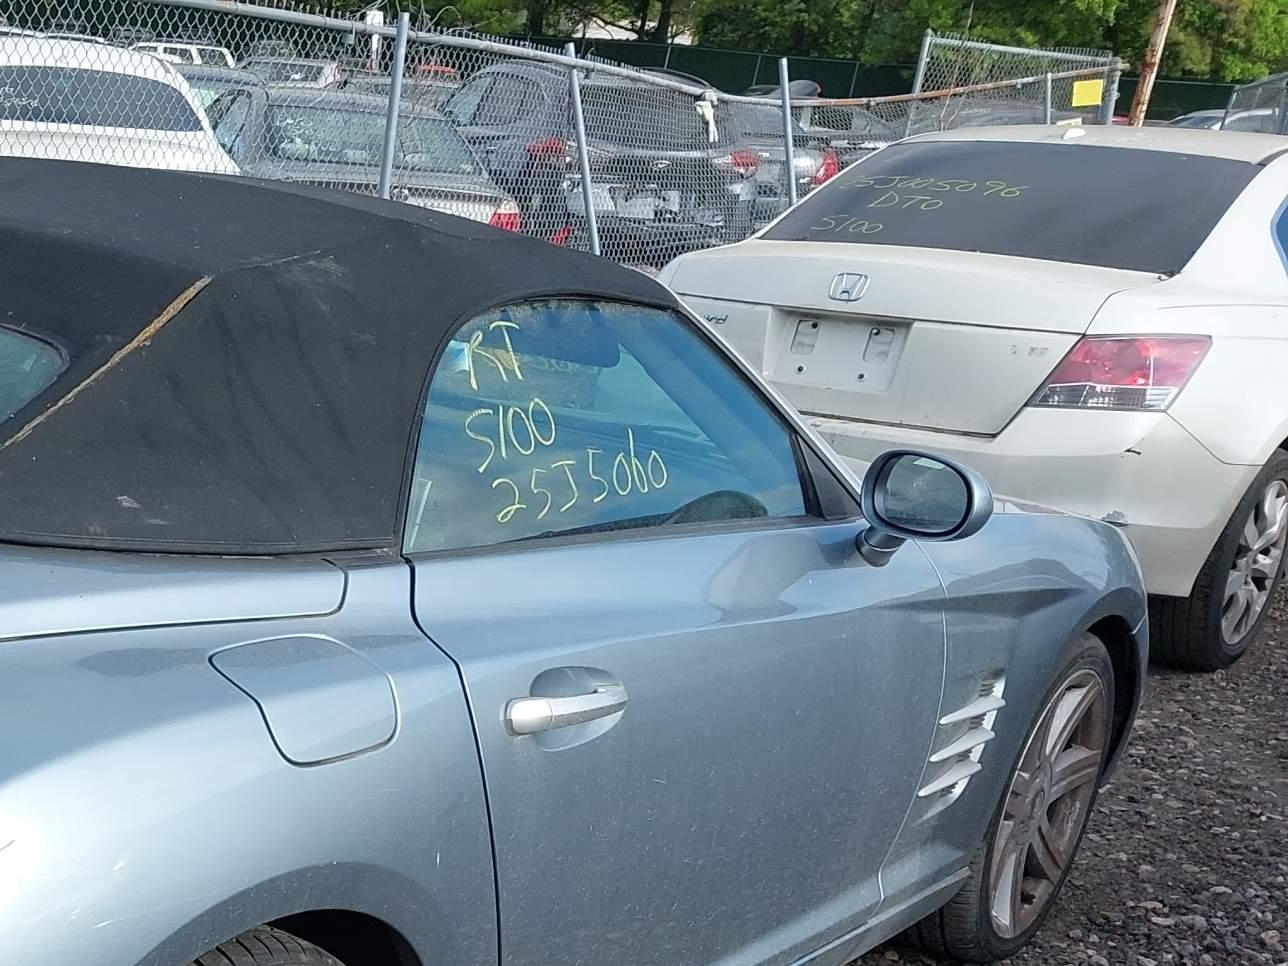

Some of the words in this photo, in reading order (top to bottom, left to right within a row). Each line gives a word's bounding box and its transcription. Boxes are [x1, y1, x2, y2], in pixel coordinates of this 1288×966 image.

[465, 320, 524, 391] RT
[465, 398, 556, 473] S100
[491, 427, 668, 523] 25J5060
